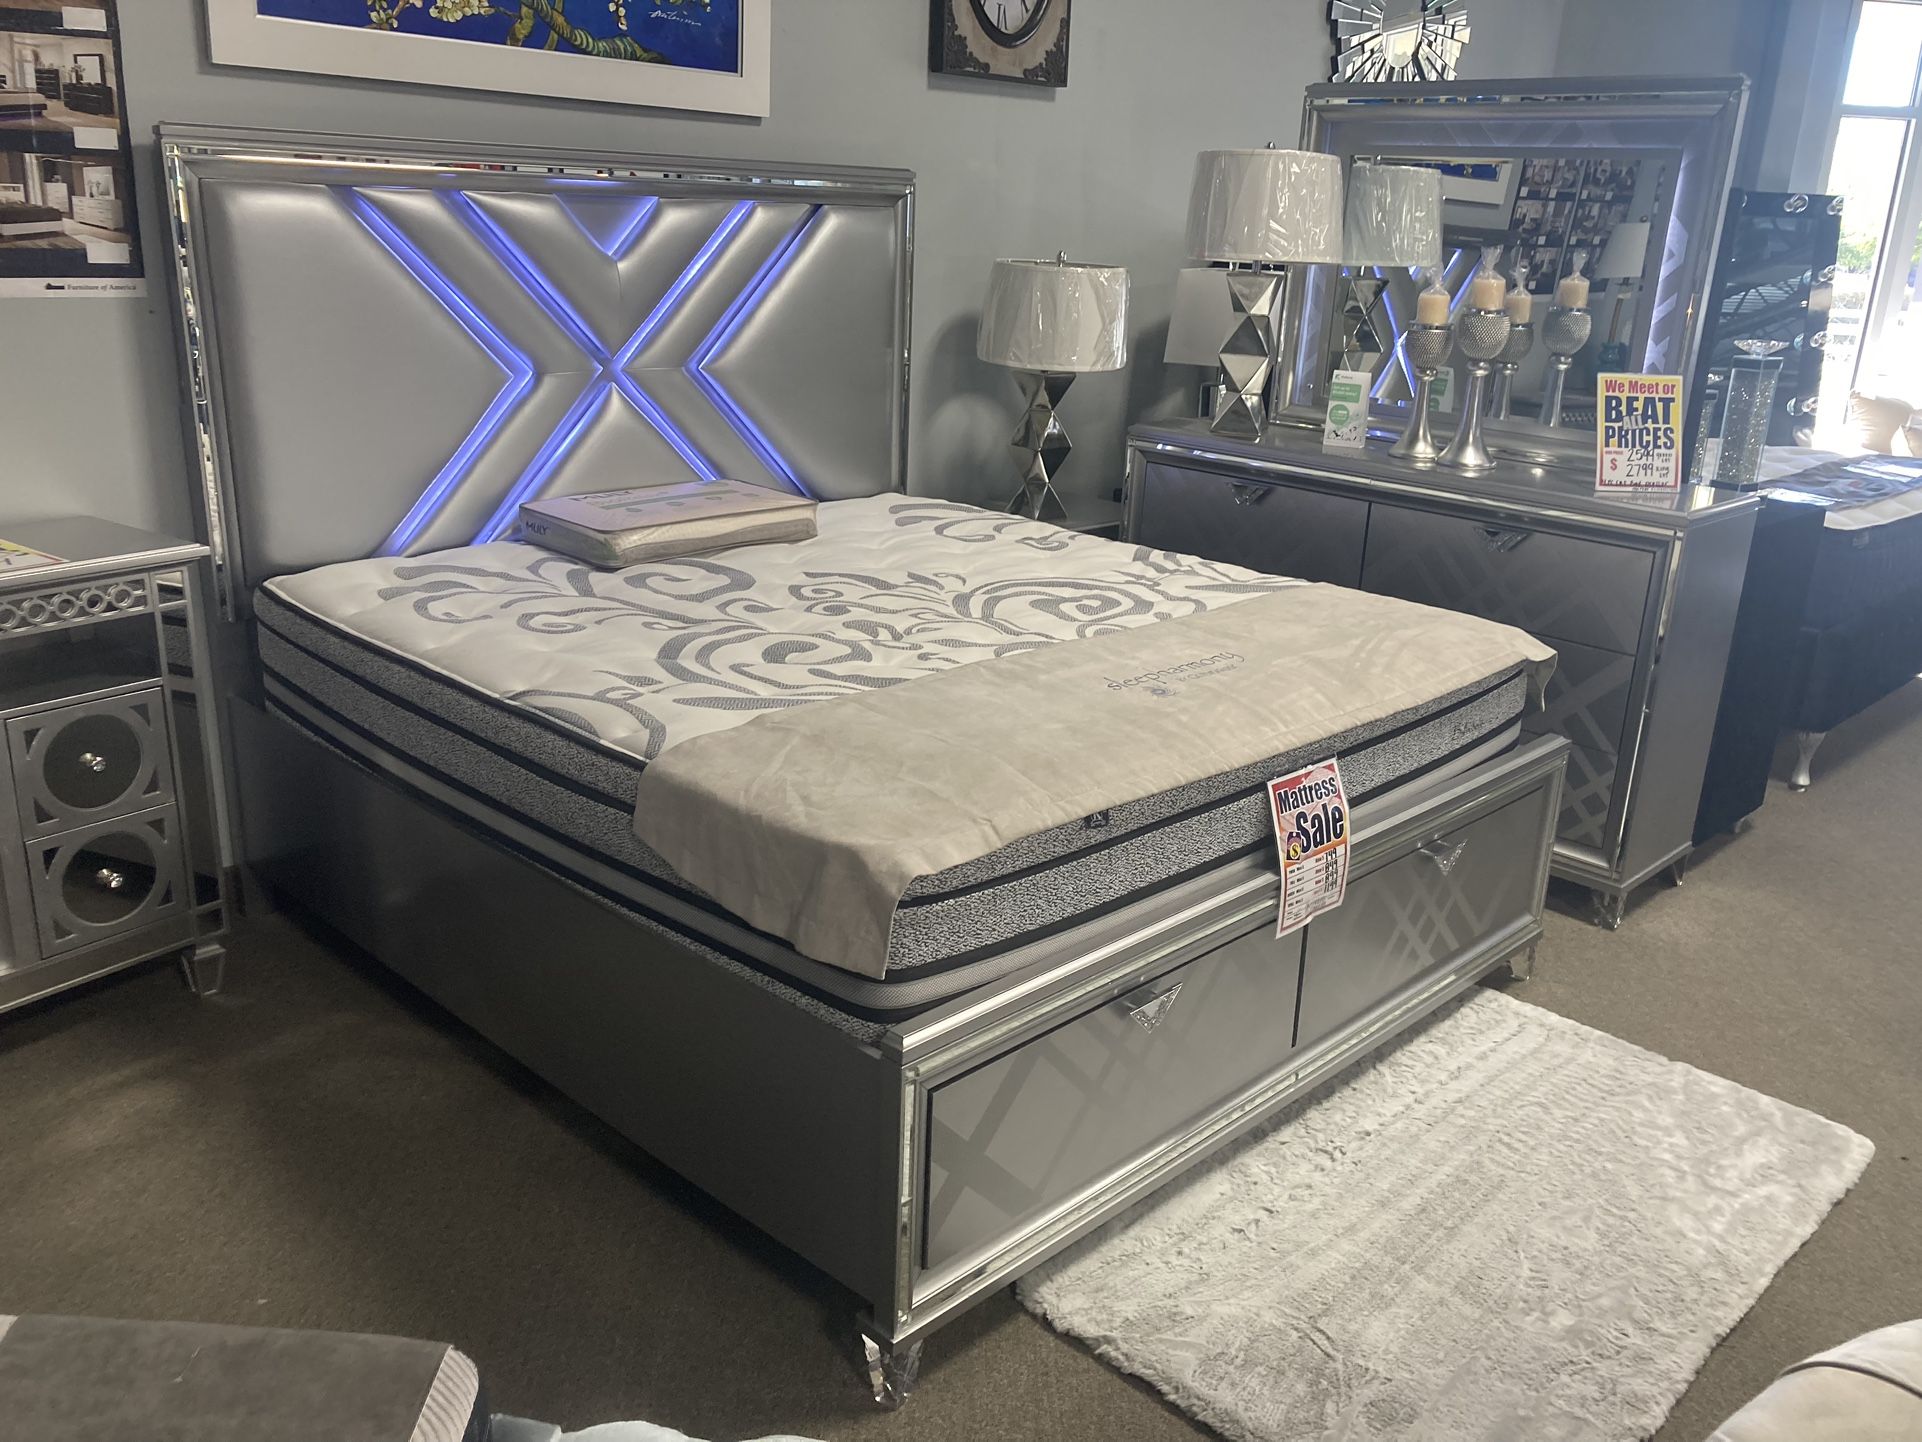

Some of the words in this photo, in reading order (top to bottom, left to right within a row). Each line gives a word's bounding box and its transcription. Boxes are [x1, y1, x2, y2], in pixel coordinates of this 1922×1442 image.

[1605, 379, 1625, 394] We
[1628, 380, 1659, 395] Meet
[1663, 383, 1676, 395] or
[1605, 395, 1675, 425] BEAT
[1623, 415, 1645, 429] ALL
[1605, 426, 1675, 450] PRICES
[1626, 463, 1654, 477] 2799
[1277, 776, 1338, 815] Mattress
[1295, 802, 1345, 853] Sale
